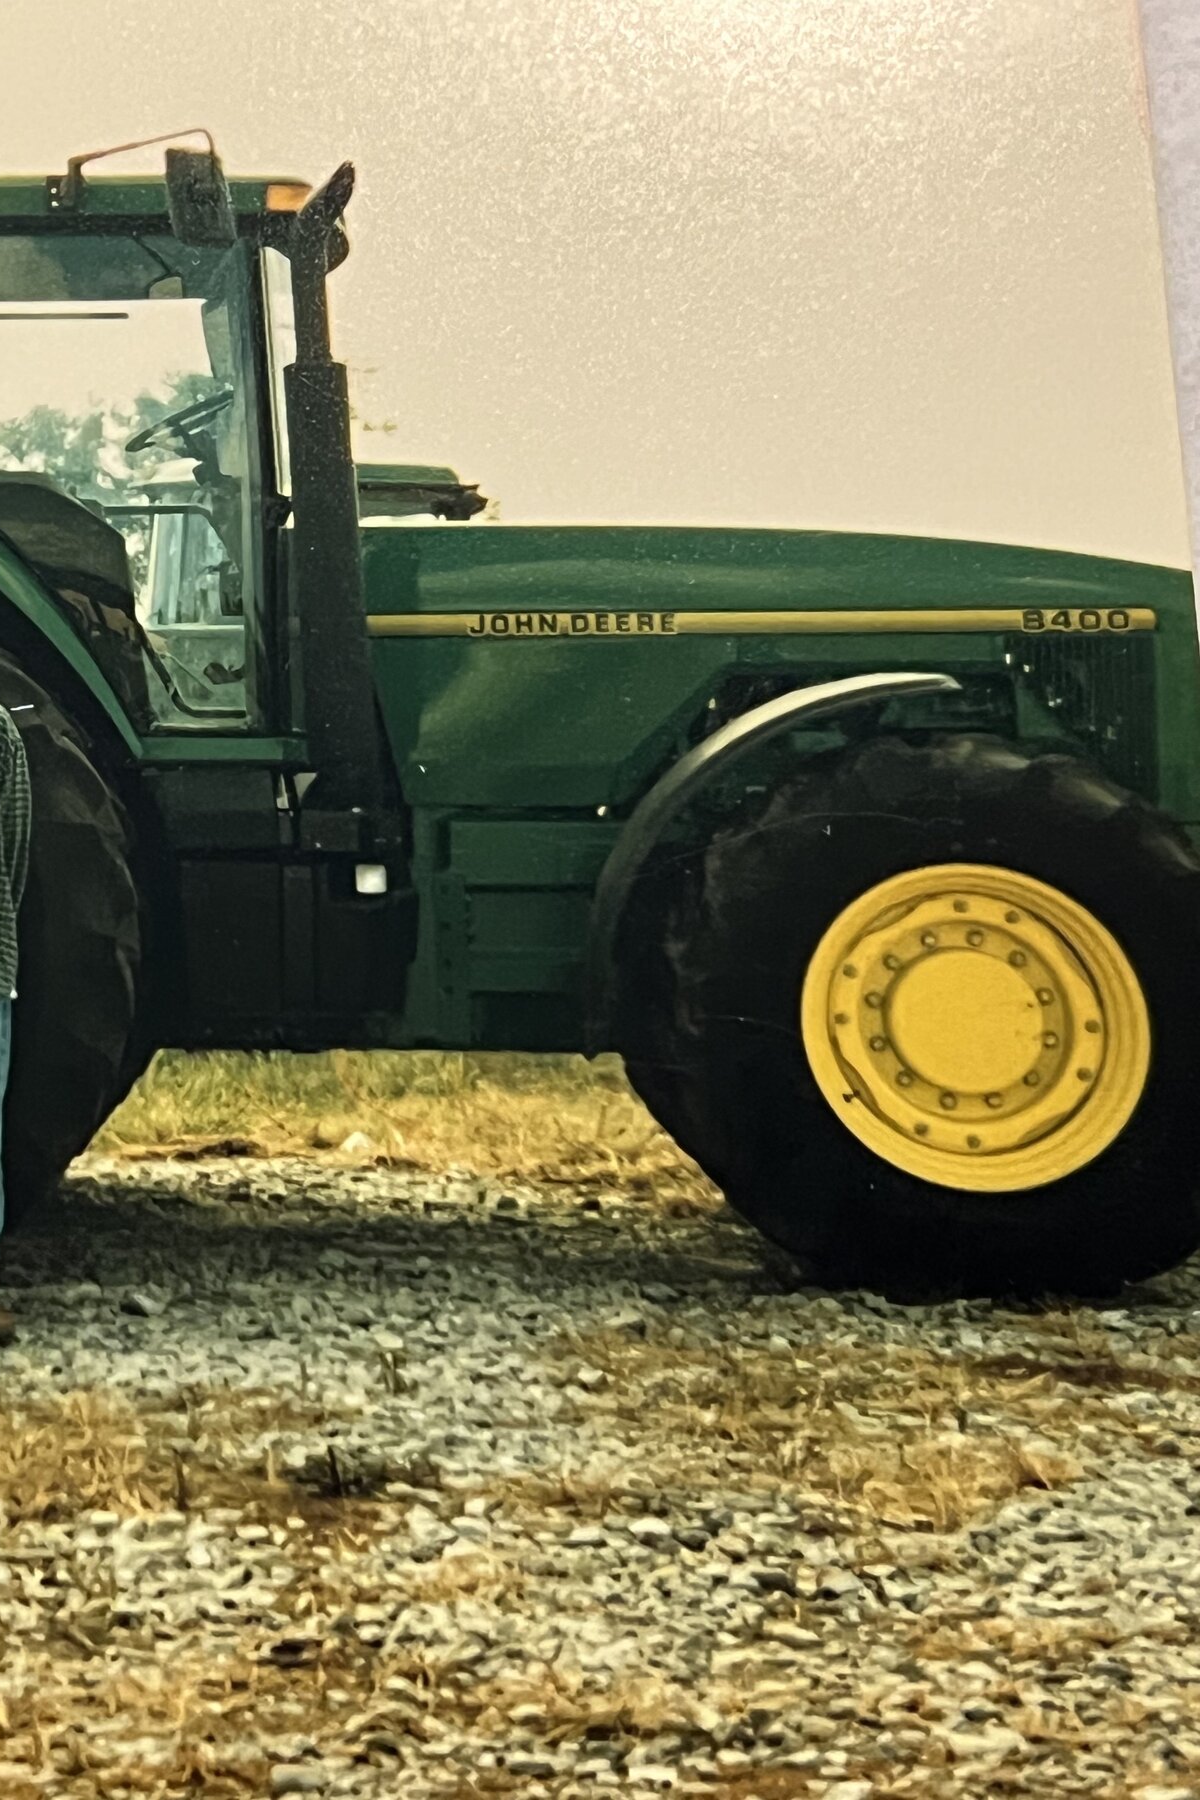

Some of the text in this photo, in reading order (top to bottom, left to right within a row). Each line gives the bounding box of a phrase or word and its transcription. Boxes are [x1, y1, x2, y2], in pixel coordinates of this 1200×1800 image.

[468, 612, 676, 635] JOHN DEERE
[1022, 609, 1130, 630] 8400
